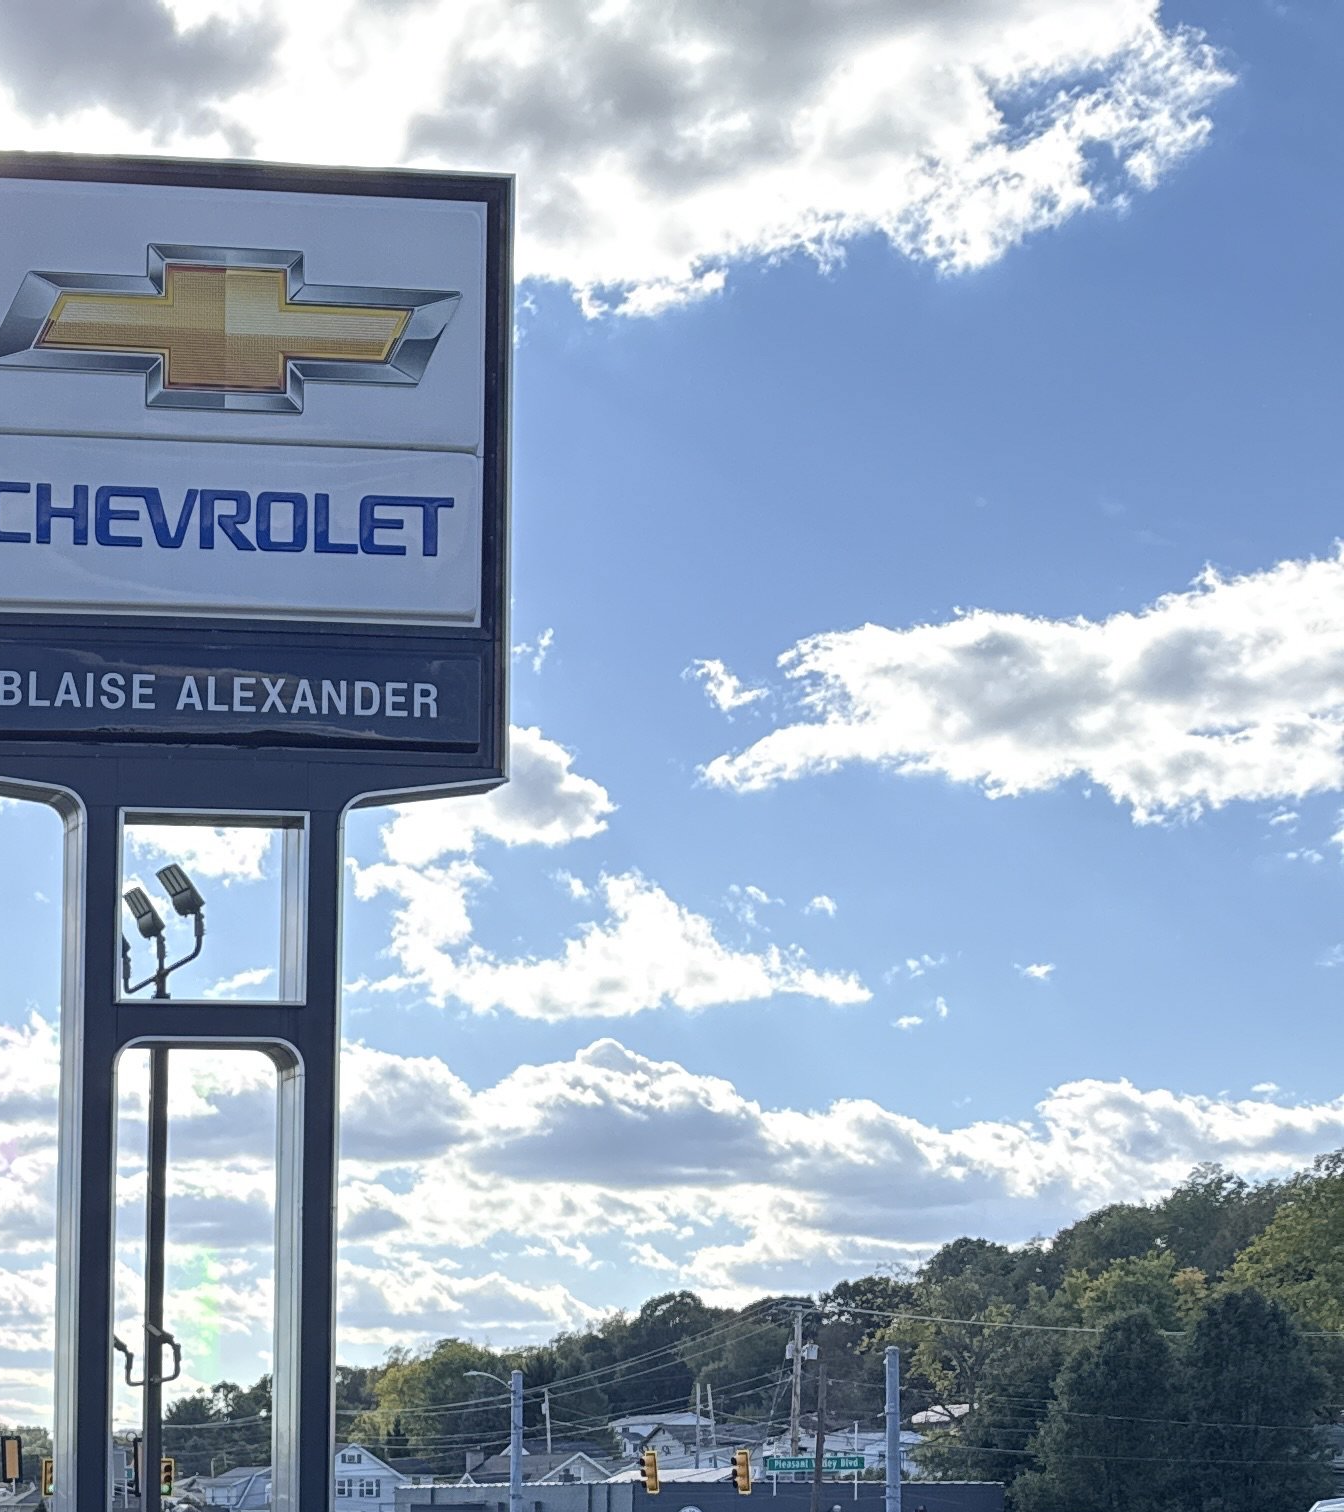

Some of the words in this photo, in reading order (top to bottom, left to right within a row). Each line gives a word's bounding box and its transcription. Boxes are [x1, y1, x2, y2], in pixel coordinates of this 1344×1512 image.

[176, 674, 439, 719] ALEXANDER
[774, 1459, 809, 1469] Pleasant
[840, 1458, 859, 1467] Blvd
